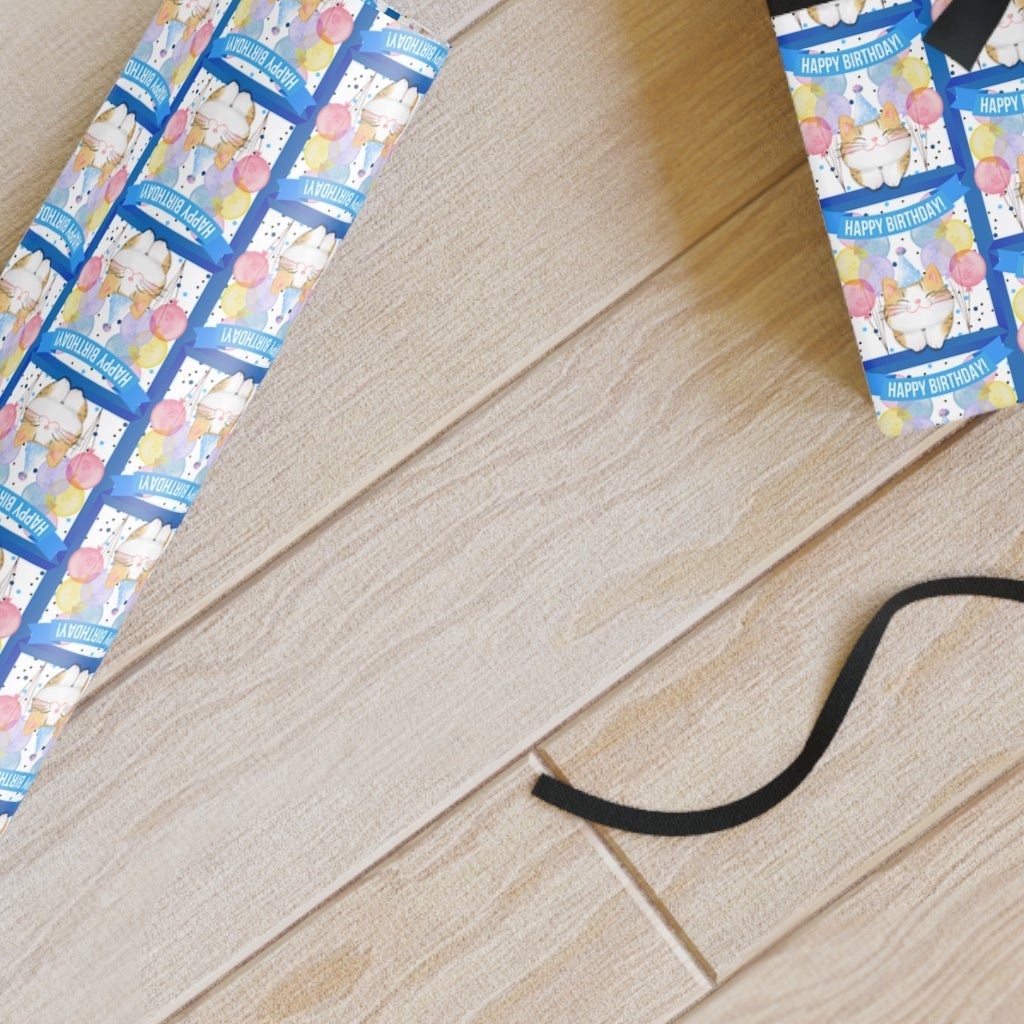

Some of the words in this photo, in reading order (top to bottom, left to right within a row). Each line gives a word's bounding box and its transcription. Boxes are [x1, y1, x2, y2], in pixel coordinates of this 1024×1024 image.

[225, 36, 270, 66] BIRTHDAY!
[386, 31, 438, 62] BIRTHDAY!
[801, 54, 840, 74] HAPPY
[843, 34, 902, 70] BIRTHDAY!
[124, 59, 156, 88] BIRTHD
[263, 56, 300, 91] HAPPY
[980, 96, 1019, 114] HAPPY
[140, 183, 186, 214] BIRTHDAY!
[303, 179, 355, 207] BIRTHDAY!
[36, 205, 72, 234] BIRTHD
[180, 205, 216, 239] HAPPY
[844, 217, 883, 237] HAPPY
[885, 196, 945, 233] BIRTHDAY!
[54, 330, 101, 364] BIRTHDAY!
[220, 327, 273, 353] BIRTHDAY!
[96, 353, 133, 388] HAPPY
[888, 378, 927, 399] HAPPY
[929, 359, 987, 394] BIRTHDAY!
[138, 475, 190, 499] BIRTHDAY!
[12, 502, 49, 537] HAPPY
